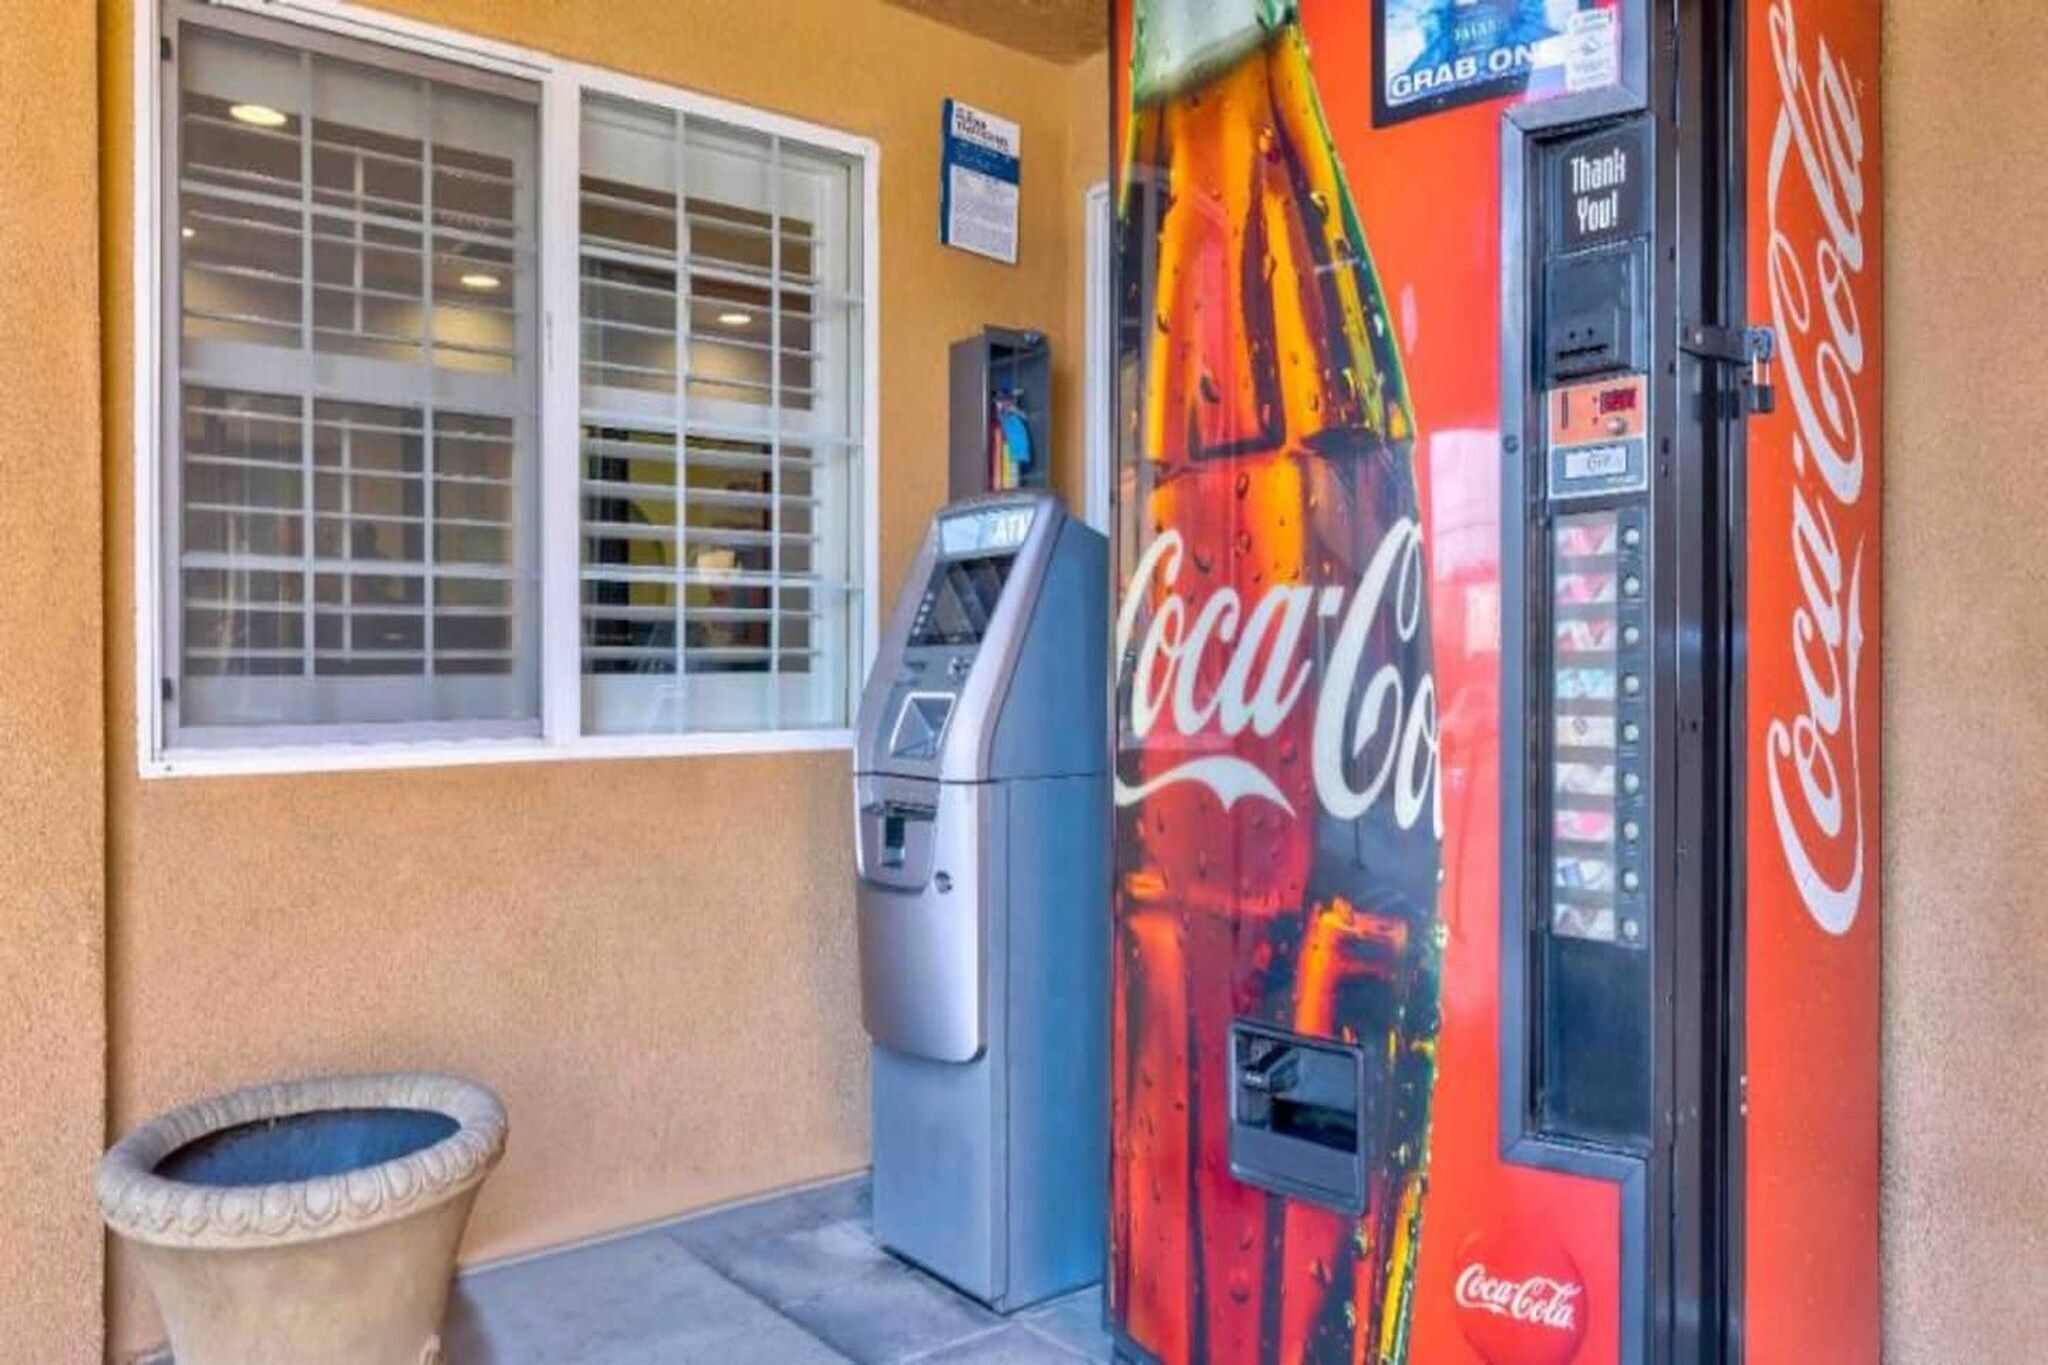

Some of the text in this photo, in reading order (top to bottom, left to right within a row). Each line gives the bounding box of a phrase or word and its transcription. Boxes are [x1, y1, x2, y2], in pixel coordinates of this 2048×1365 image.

[1391, 56, 1477, 97] GRAB
[1570, 147, 1626, 194] Thank
[1577, 190, 1618, 233] You!
[1767, 0, 1863, 935] Coca-Cola
[1116, 517, 1443, 840] Coca-Co
[1455, 1262, 1582, 1331] Coca-Cola
